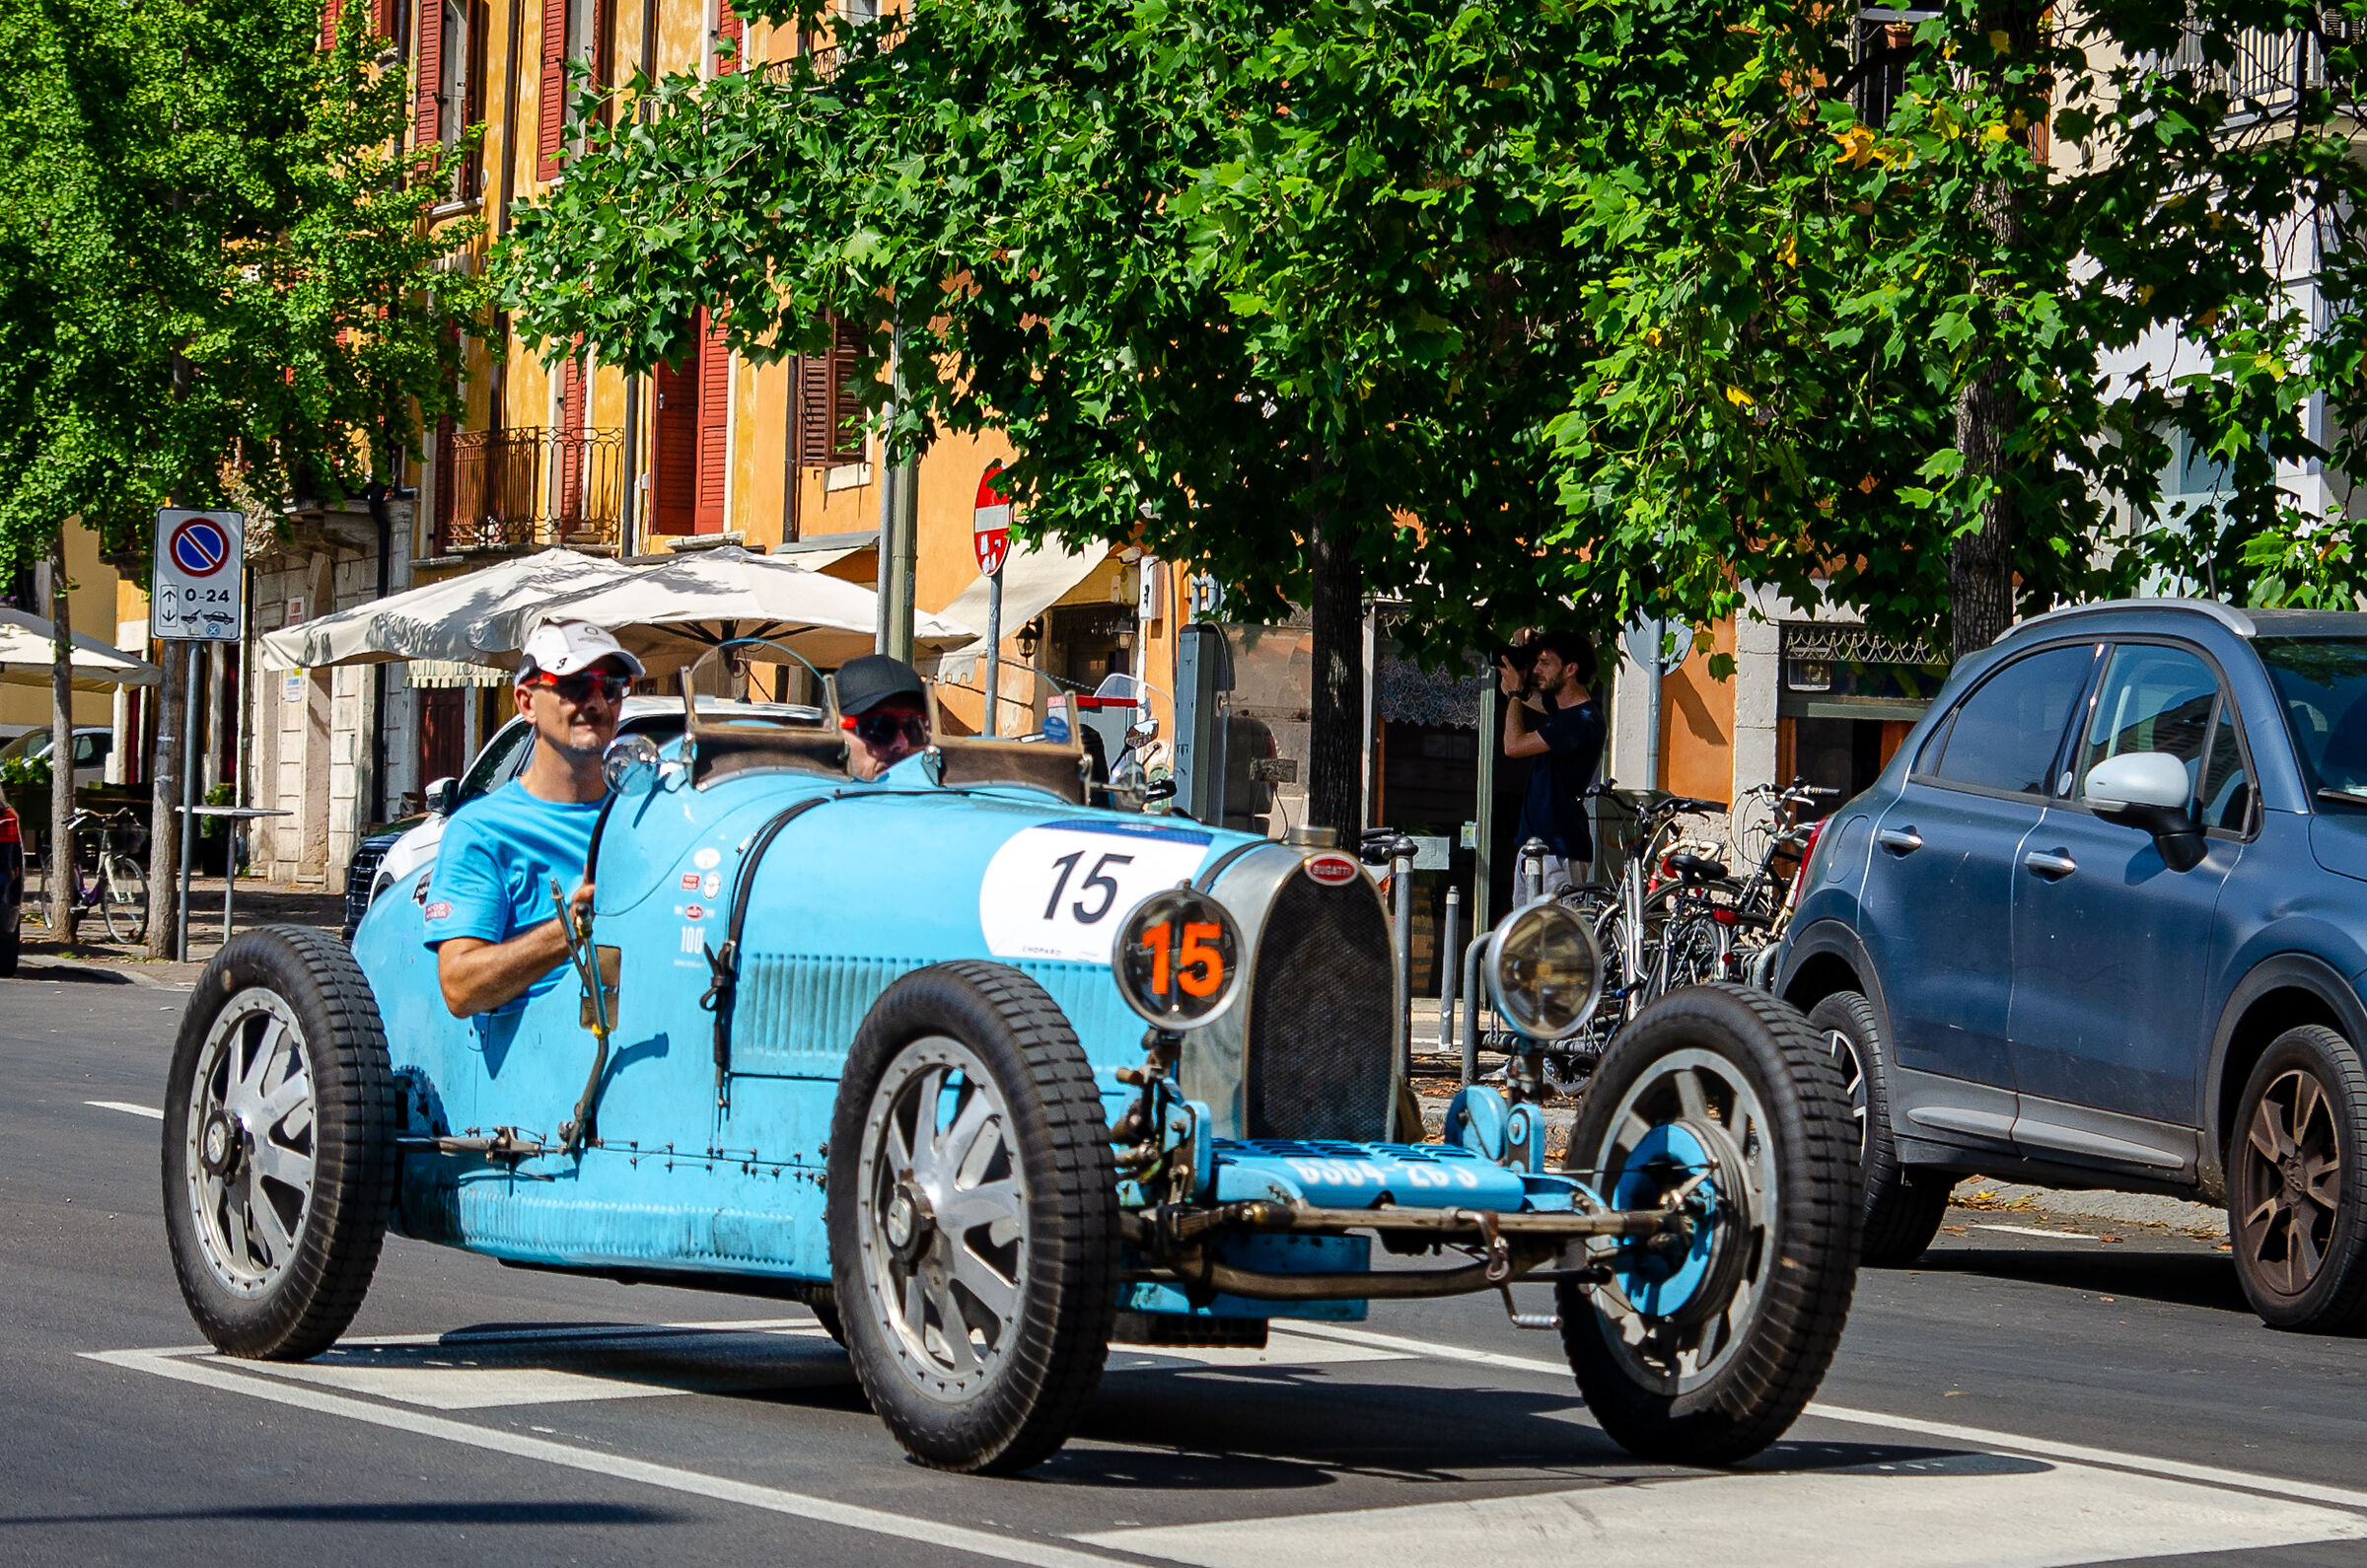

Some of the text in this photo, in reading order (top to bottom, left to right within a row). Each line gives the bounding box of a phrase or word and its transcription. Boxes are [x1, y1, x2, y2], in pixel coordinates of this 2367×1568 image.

[184, 588, 230, 604] 0-24
[1042, 849, 1135, 925] 15
[1141, 921, 1224, 997] 15
